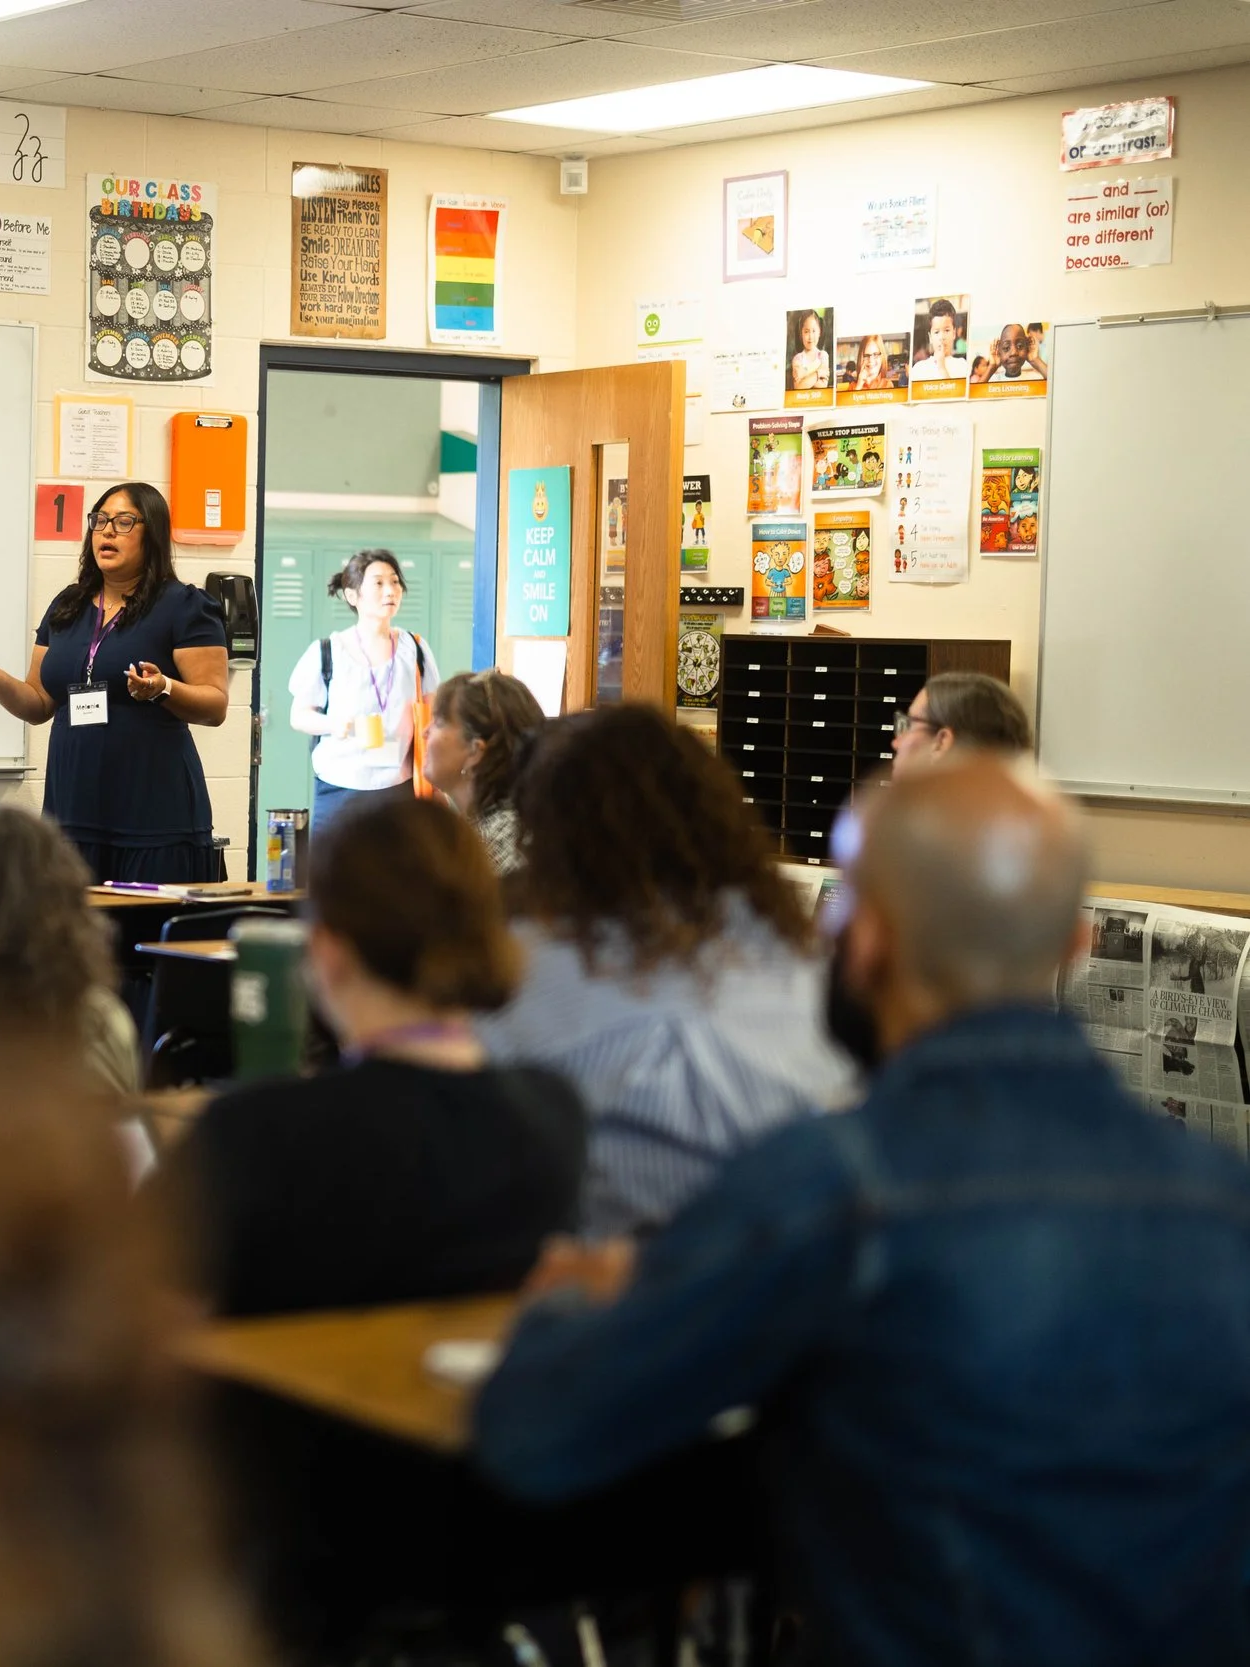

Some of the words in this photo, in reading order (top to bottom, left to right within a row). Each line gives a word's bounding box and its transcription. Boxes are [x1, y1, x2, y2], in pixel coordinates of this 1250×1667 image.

[102, 178, 140, 198] OUR
[145, 181, 202, 202] CLASS
[1103, 182, 1129, 198] and
[101, 198, 202, 221] BIRTHDAYS
[301, 196, 337, 224] LISTEN
[337, 199, 350, 210] Say
[352, 200, 374, 211] Please
[1067, 211, 1091, 225] are
[1096, 205, 1140, 222] similar
[1146, 200, 1170, 218] (or)
[3, 219, 32, 234] Before
[36, 221, 50, 236] Me
[301, 223, 312, 235] BE
[314, 224, 342, 238] READY
[343, 226, 354, 238] TO
[354, 227, 380, 239] LEARN
[1066, 234, 1090, 247] are
[1095, 226, 1154, 245] different
[301, 236, 330, 254] Smile
[333, 237, 363, 257] DREAM
[365, 239, 380, 258] BIG
[300, 254, 329, 269] Raise
[330, 256, 354, 271] Your
[355, 257, 380, 273] Hand
[1065, 254, 1129, 270] because...
[300, 269, 318, 282] Use
[322, 270, 346, 285] Kind
[350, 272, 380, 286] Words
[299, 284, 326, 293] ALWAYS
[328, 285, 337, 293] DO
[338, 286, 355, 304] Follow
[355, 286, 380, 305] Directions
[300, 293, 318, 302] YOUR
[320, 294, 337, 303] BEST
[324, 303, 343, 313] hard
[300, 312, 314, 323] Use
[315, 316, 334, 326] your
[336, 314, 379, 328] imagination
[817, 430, 834, 438] HELP
[835, 428, 850, 436] STOP
[851, 425, 879, 435] BULLYING
[53, 494, 65, 533] 1
[525, 527, 555, 545] KEEP
[523, 548, 556, 567] CALM
[533, 569, 547, 579] AND
[522, 583, 556, 601] SMILE
[529, 605, 549, 623] ON
[1152, 990, 1158, 999] A
[1160, 991, 1205, 1006] BIRD'S-EYE
[1207, 997, 1229, 1010] VIEW
[1160, 1000, 1197, 1015] CLIMATE
[1199, 1006, 1232, 1021] CHANGE
